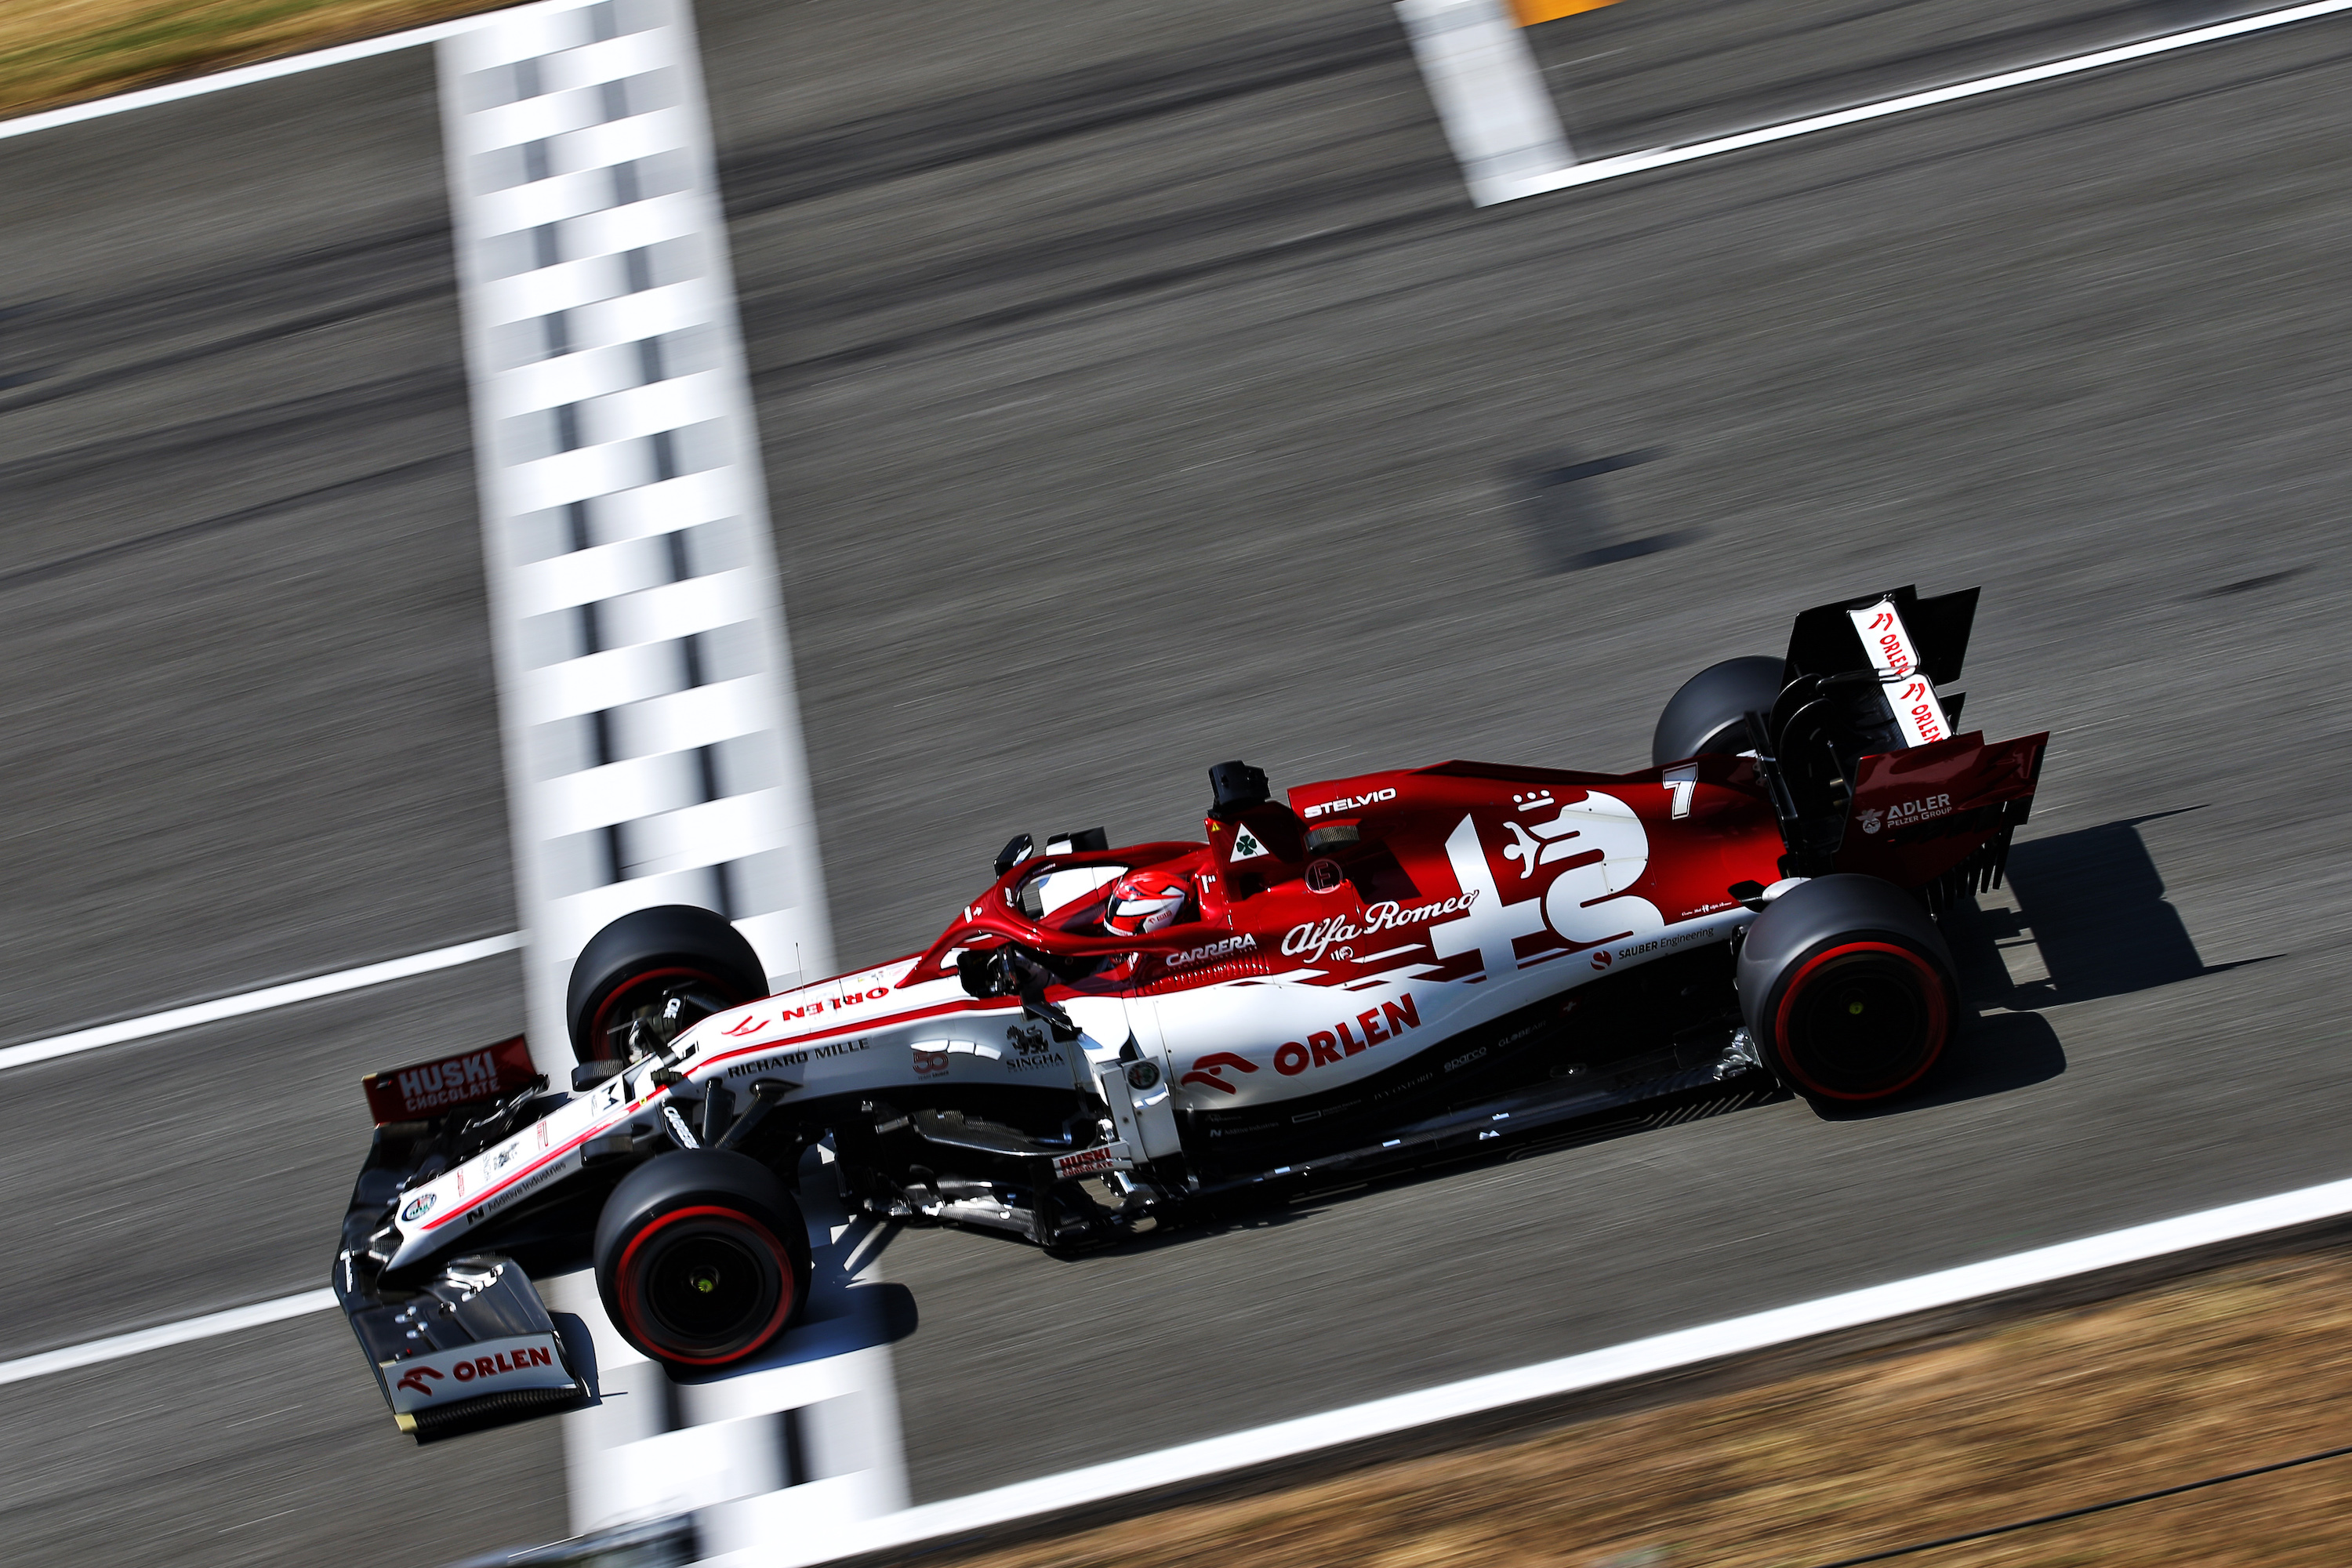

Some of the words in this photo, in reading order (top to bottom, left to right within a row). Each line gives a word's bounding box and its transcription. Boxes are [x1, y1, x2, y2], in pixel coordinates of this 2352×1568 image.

[1879, 633, 1911, 675] ORLEN
[1304, 787, 1396, 818] STELVIO
[1663, 762, 1698, 820] 7
[1887, 793, 1951, 820] ADLER
[1887, 815, 1919, 829] PELZER
[1921, 807, 1953, 820] GROUP
[1281, 913, 1363, 964] Alfa
[1363, 889, 1480, 935] Romeo
[1618, 941, 1658, 960] SAUBER
[1660, 927, 1715, 948] Engineering
[1166, 933, 1257, 967] CARRERA
[782, 987, 889, 1022] ORLEN
[1273, 993, 1421, 1076] ORLEN
[397, 1051, 496, 1098] HUSKI
[728, 1051, 809, 1079] RICHARD
[815, 1037, 871, 1060] MILLE
[912, 1051, 949, 1074] 50
[1006, 1053, 1064, 1068] SINGHA
[1443, 1046, 1487, 1073] sparco
[405, 1077, 501, 1112] CHOCOLATE
[1059, 1147, 1112, 1168] HUSKI
[488, 1185, 524, 1213] Additive
[522, 1160, 567, 1192] Industries
[452, 1346, 553, 1383] ORLEN
